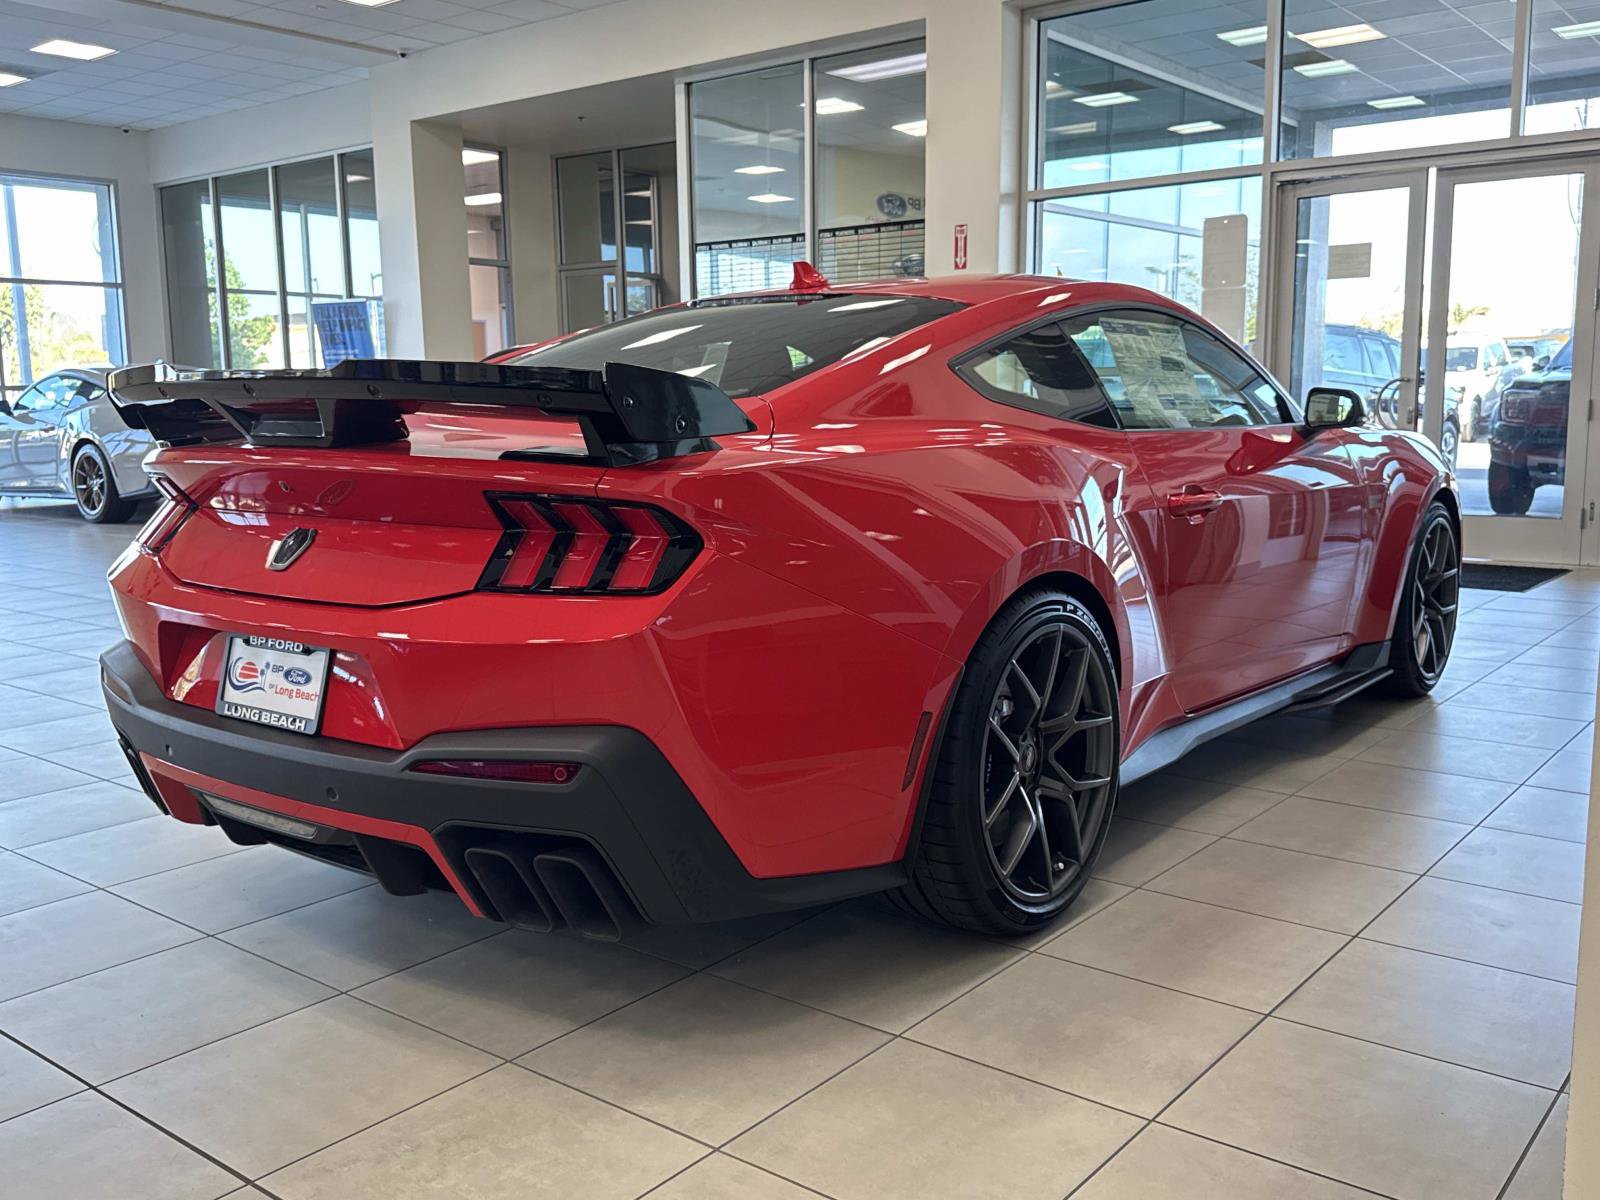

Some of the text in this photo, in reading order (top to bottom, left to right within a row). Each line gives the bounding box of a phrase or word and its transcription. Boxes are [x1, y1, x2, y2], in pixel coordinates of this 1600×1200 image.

[250, 636, 303, 652] BP FORD
[271, 664, 285, 673] BP
[275, 684, 294, 699] Long
[295, 688, 320, 702] Beach
[261, 712, 306, 731] BEACH
